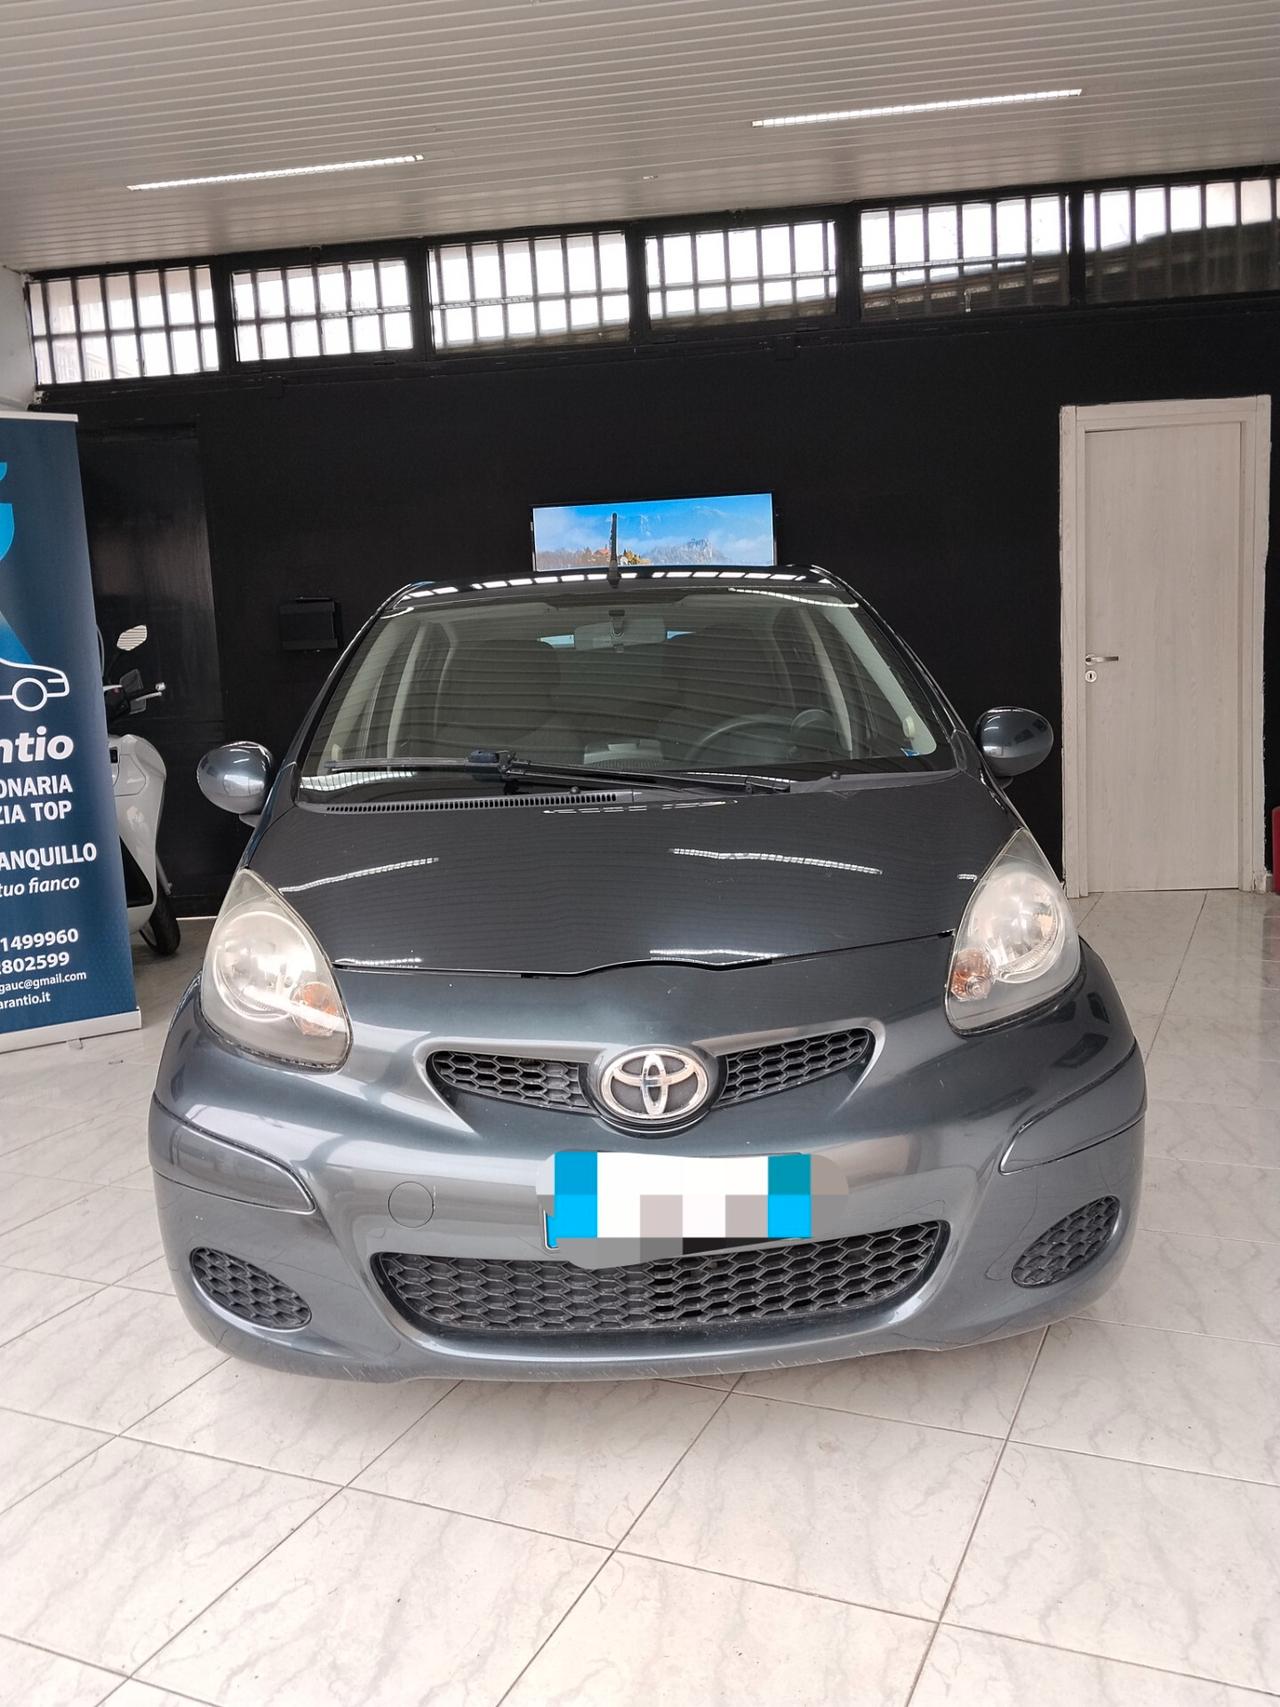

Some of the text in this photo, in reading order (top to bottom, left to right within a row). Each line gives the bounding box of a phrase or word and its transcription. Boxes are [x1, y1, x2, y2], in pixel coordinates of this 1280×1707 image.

[30, 800, 72, 821] TOP
[0, 842, 97, 871] ANQUILLO
[29, 877, 80, 894] fianco
[0, 951, 70, 975] 802599
